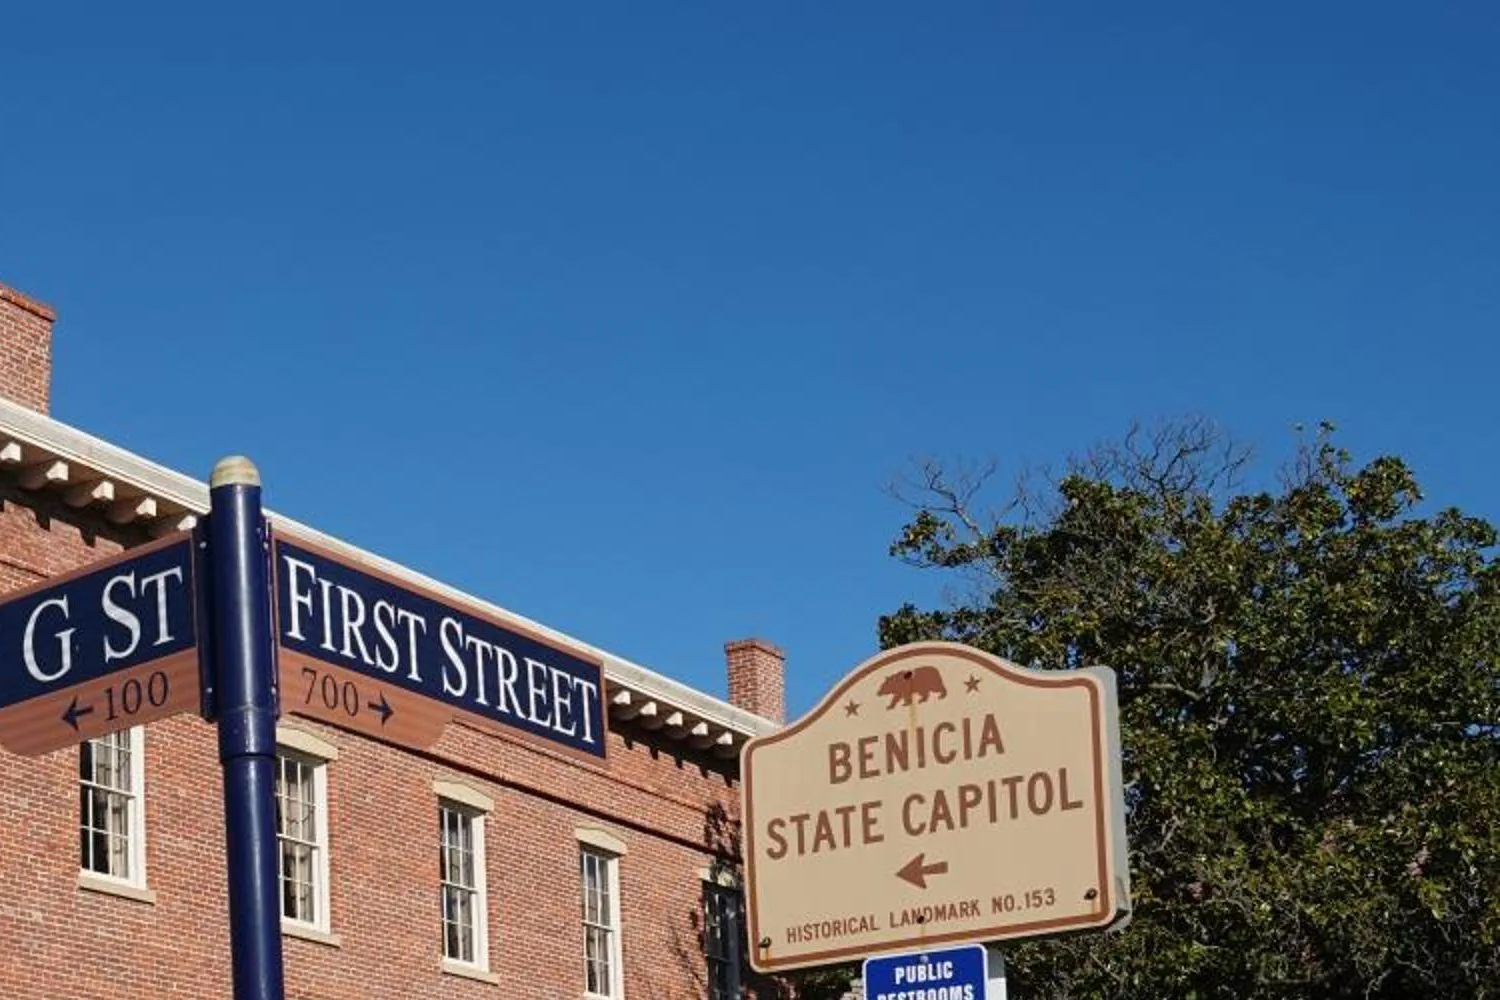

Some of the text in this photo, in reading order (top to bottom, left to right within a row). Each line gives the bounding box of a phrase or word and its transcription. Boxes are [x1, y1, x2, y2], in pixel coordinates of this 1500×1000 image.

[23, 594, 77, 682] G
[101, 565, 183, 664] ST
[282, 555, 598, 745] FIRST STREET
[105, 671, 169, 721] 100
[301, 667, 360, 717] 700
[828, 713, 1005, 785] BENICIA
[766, 768, 1084, 861] STATE CAPITOL
[787, 914, 880, 944] HISTORICAL
[889, 900, 981, 929] LANDMARK
[895, 962, 954, 985] PUBLIC
